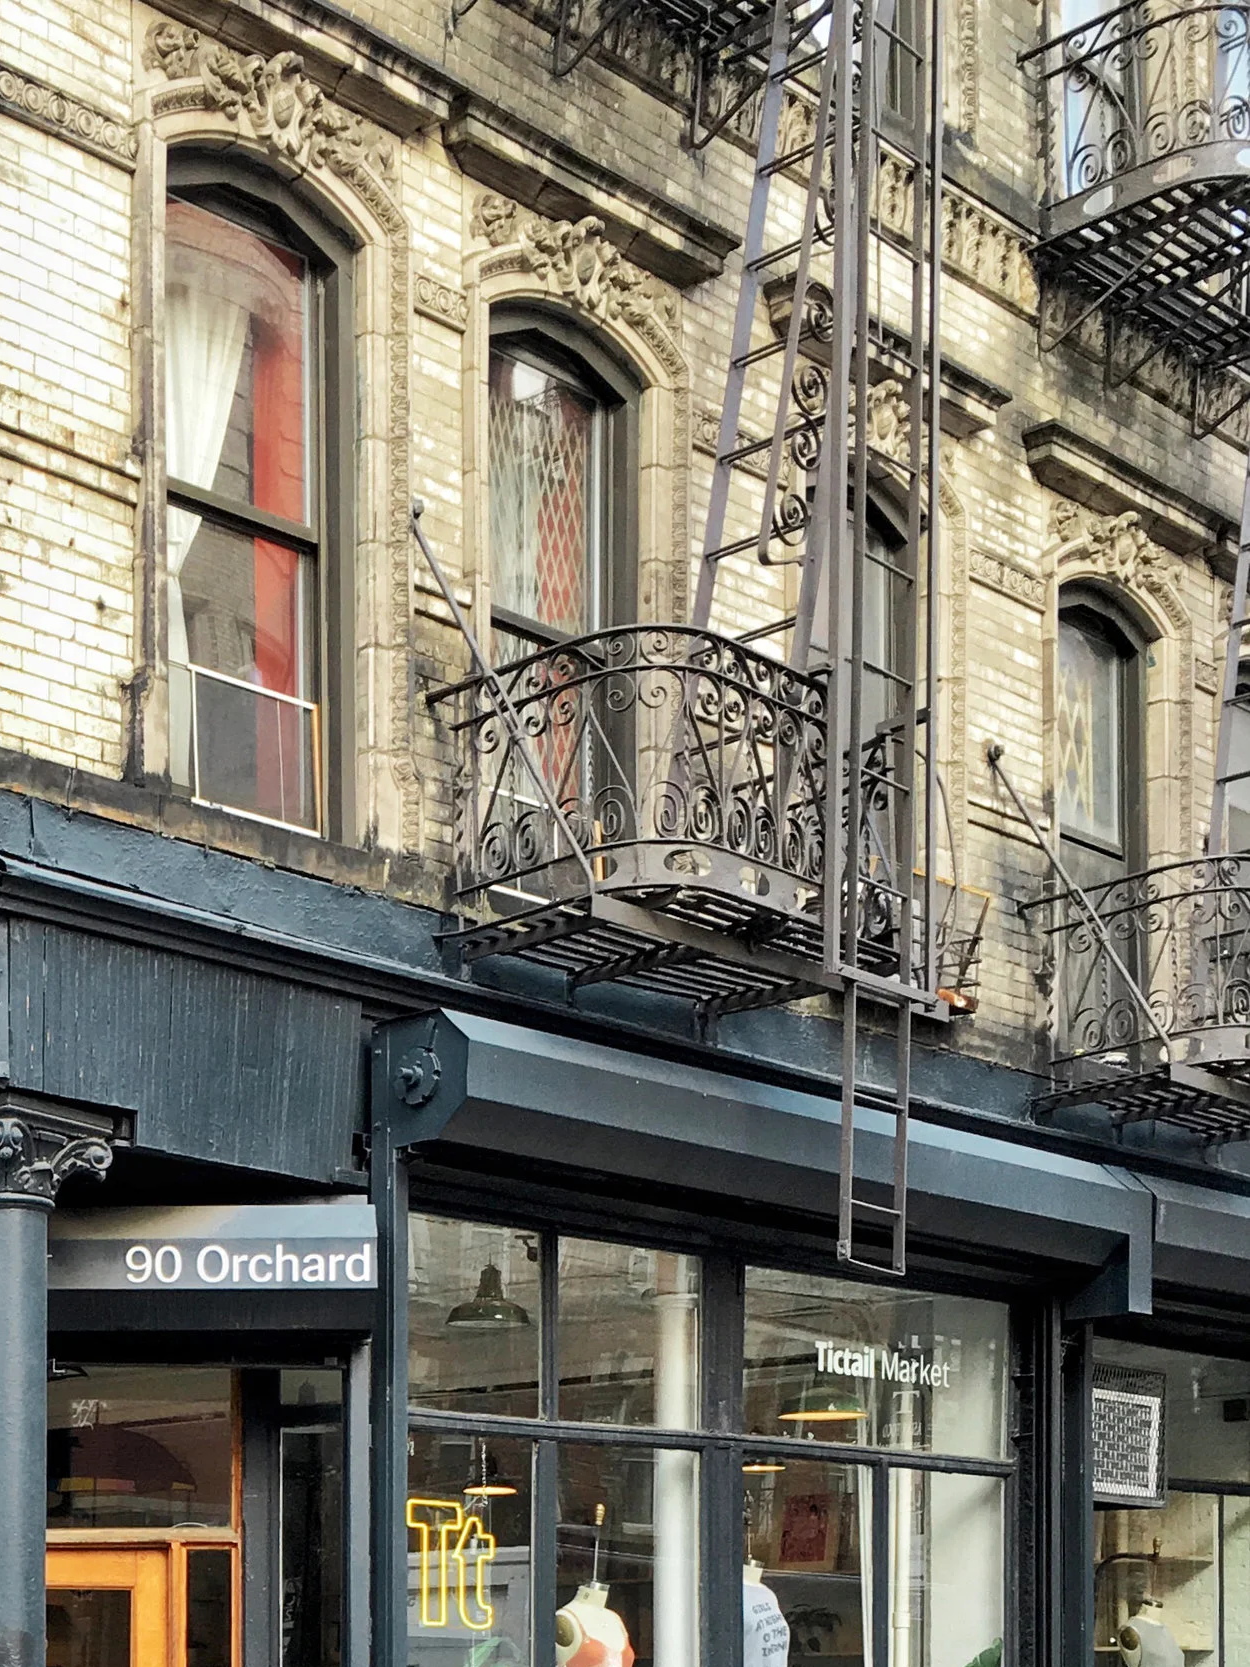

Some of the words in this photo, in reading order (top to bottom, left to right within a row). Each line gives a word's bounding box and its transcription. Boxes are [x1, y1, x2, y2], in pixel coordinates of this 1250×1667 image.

[125, 1244, 183, 1284] 90
[196, 1243, 372, 1284] Orchard
[814, 1340, 875, 1379] Tictail
[881, 1350, 950, 1388] Market
